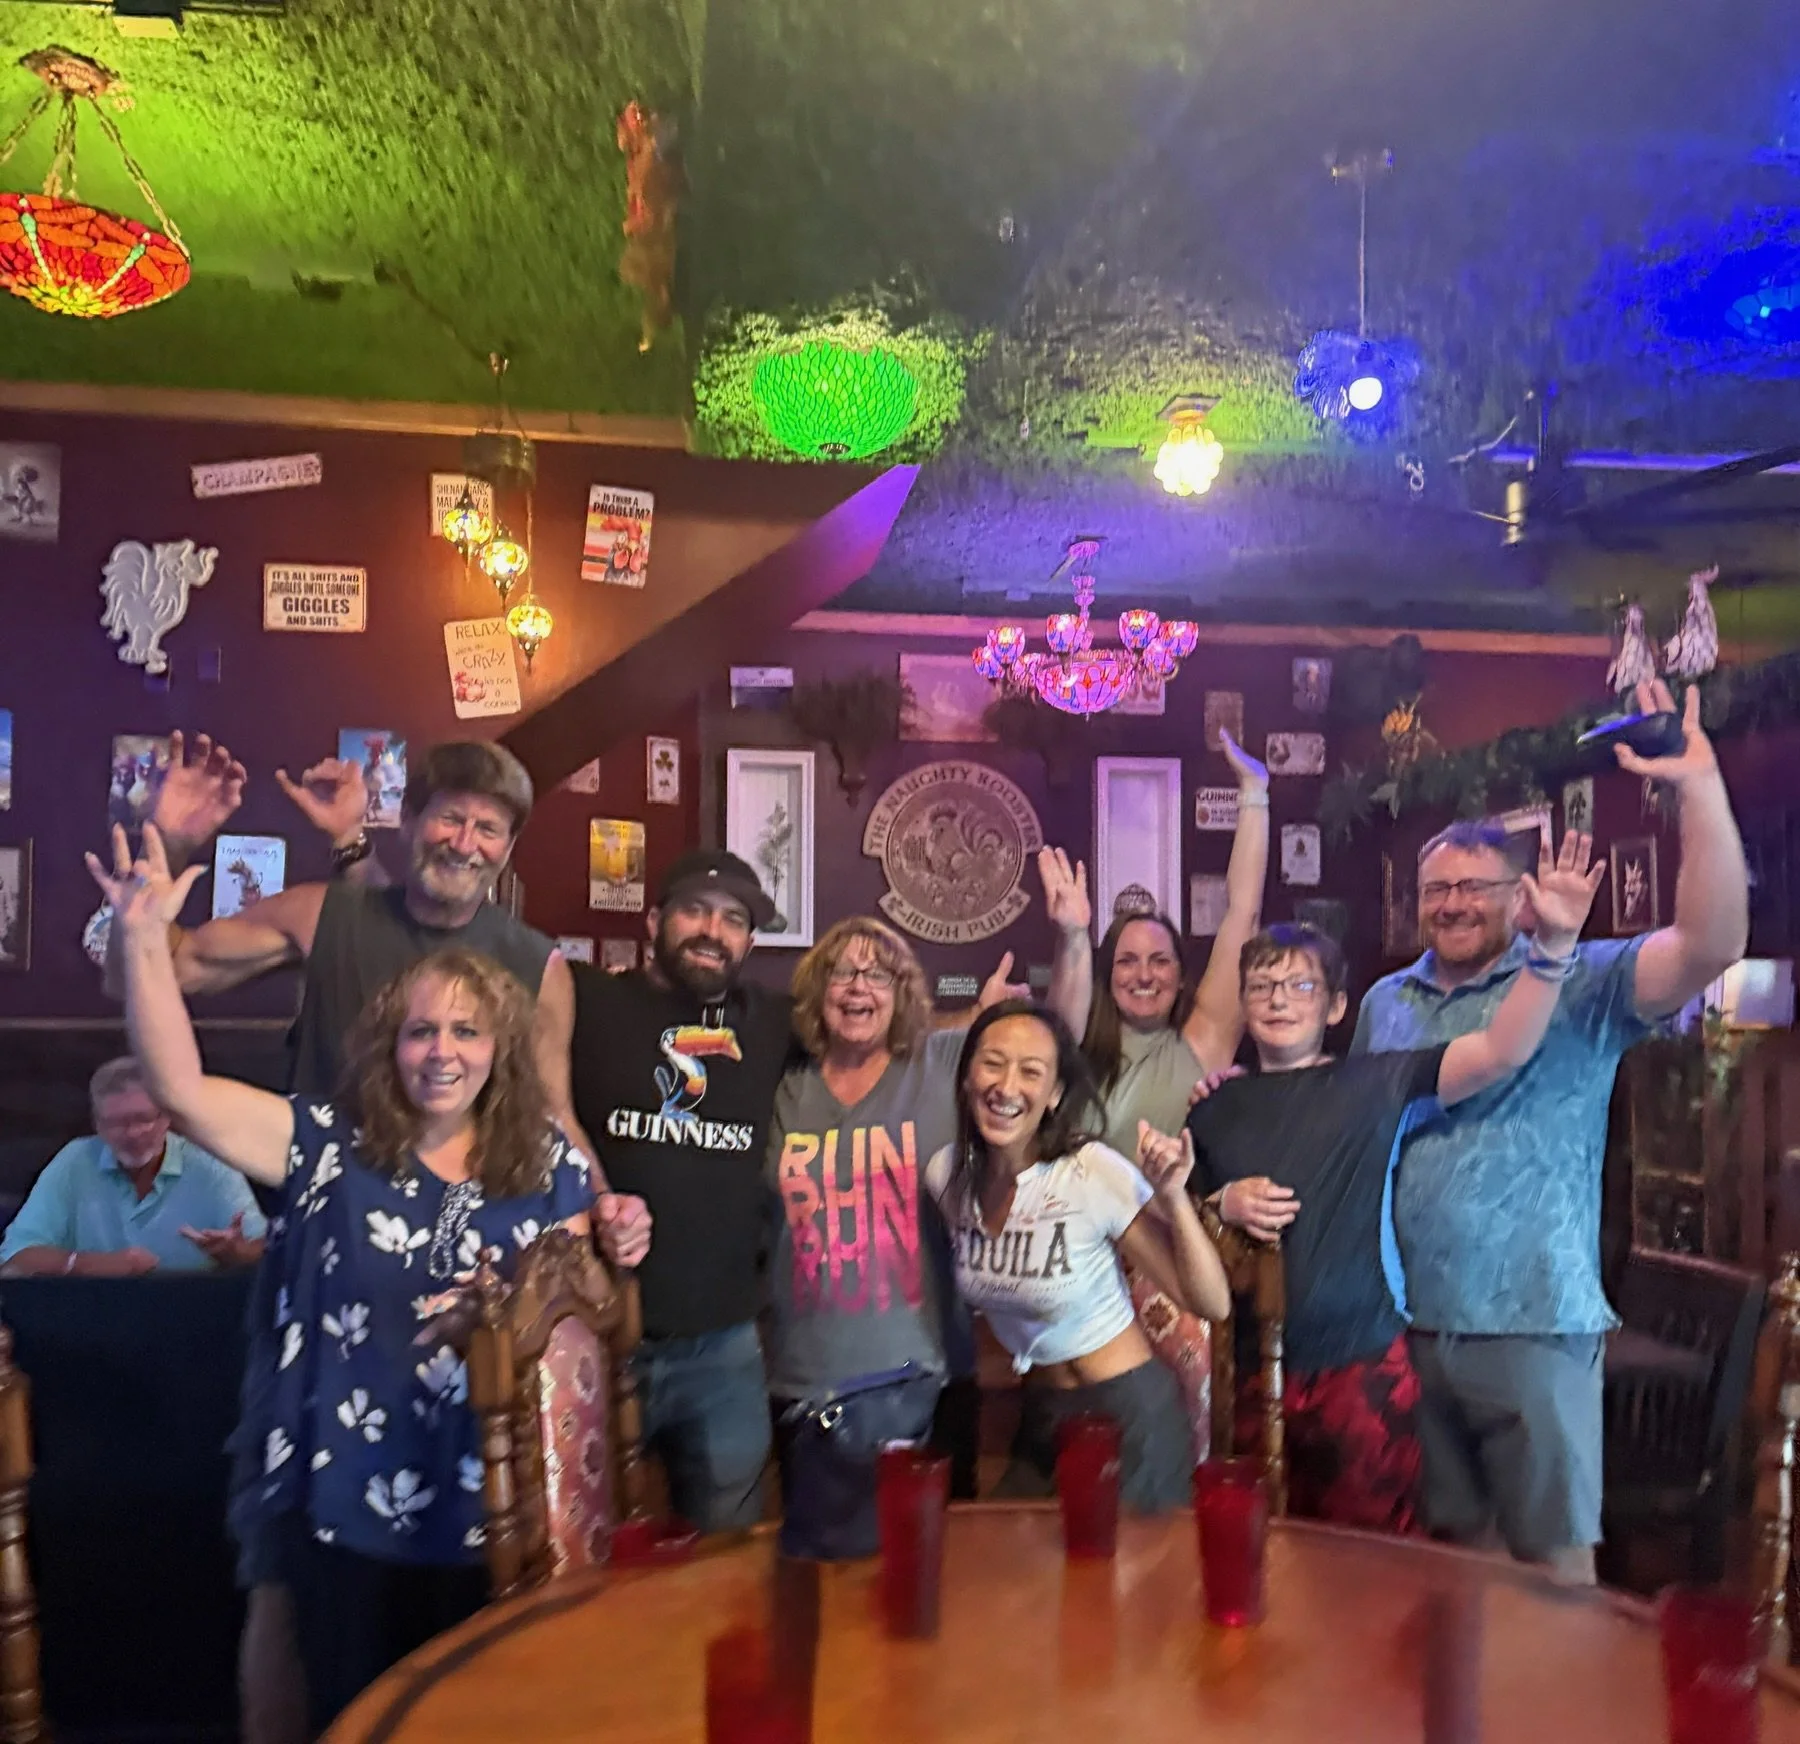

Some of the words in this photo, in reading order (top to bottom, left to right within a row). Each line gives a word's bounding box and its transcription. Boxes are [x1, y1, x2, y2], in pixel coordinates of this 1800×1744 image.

[203, 461, 320, 490] CHAMPAGNE
[593, 502, 651, 520] PROBLEM?
[291, 571, 307, 581] ALL
[310, 572, 338, 582] SHITS
[339, 573, 360, 582] AND
[325, 583, 360, 597] SOMEONE
[282, 597, 350, 615] GIGGLES
[286, 615, 307, 626] AND
[869, 815, 888, 850] THE
[885, 767, 970, 813] NAUGHTY
[977, 771, 1038, 847] ROOSTER
[904, 911, 959, 939] IRISH
[968, 910, 1006, 937] PUB
[606, 1107, 754, 1152] GUINNESS
[779, 1120, 918, 1206] RUN
[955, 1222, 1072, 1280] EQUILA
